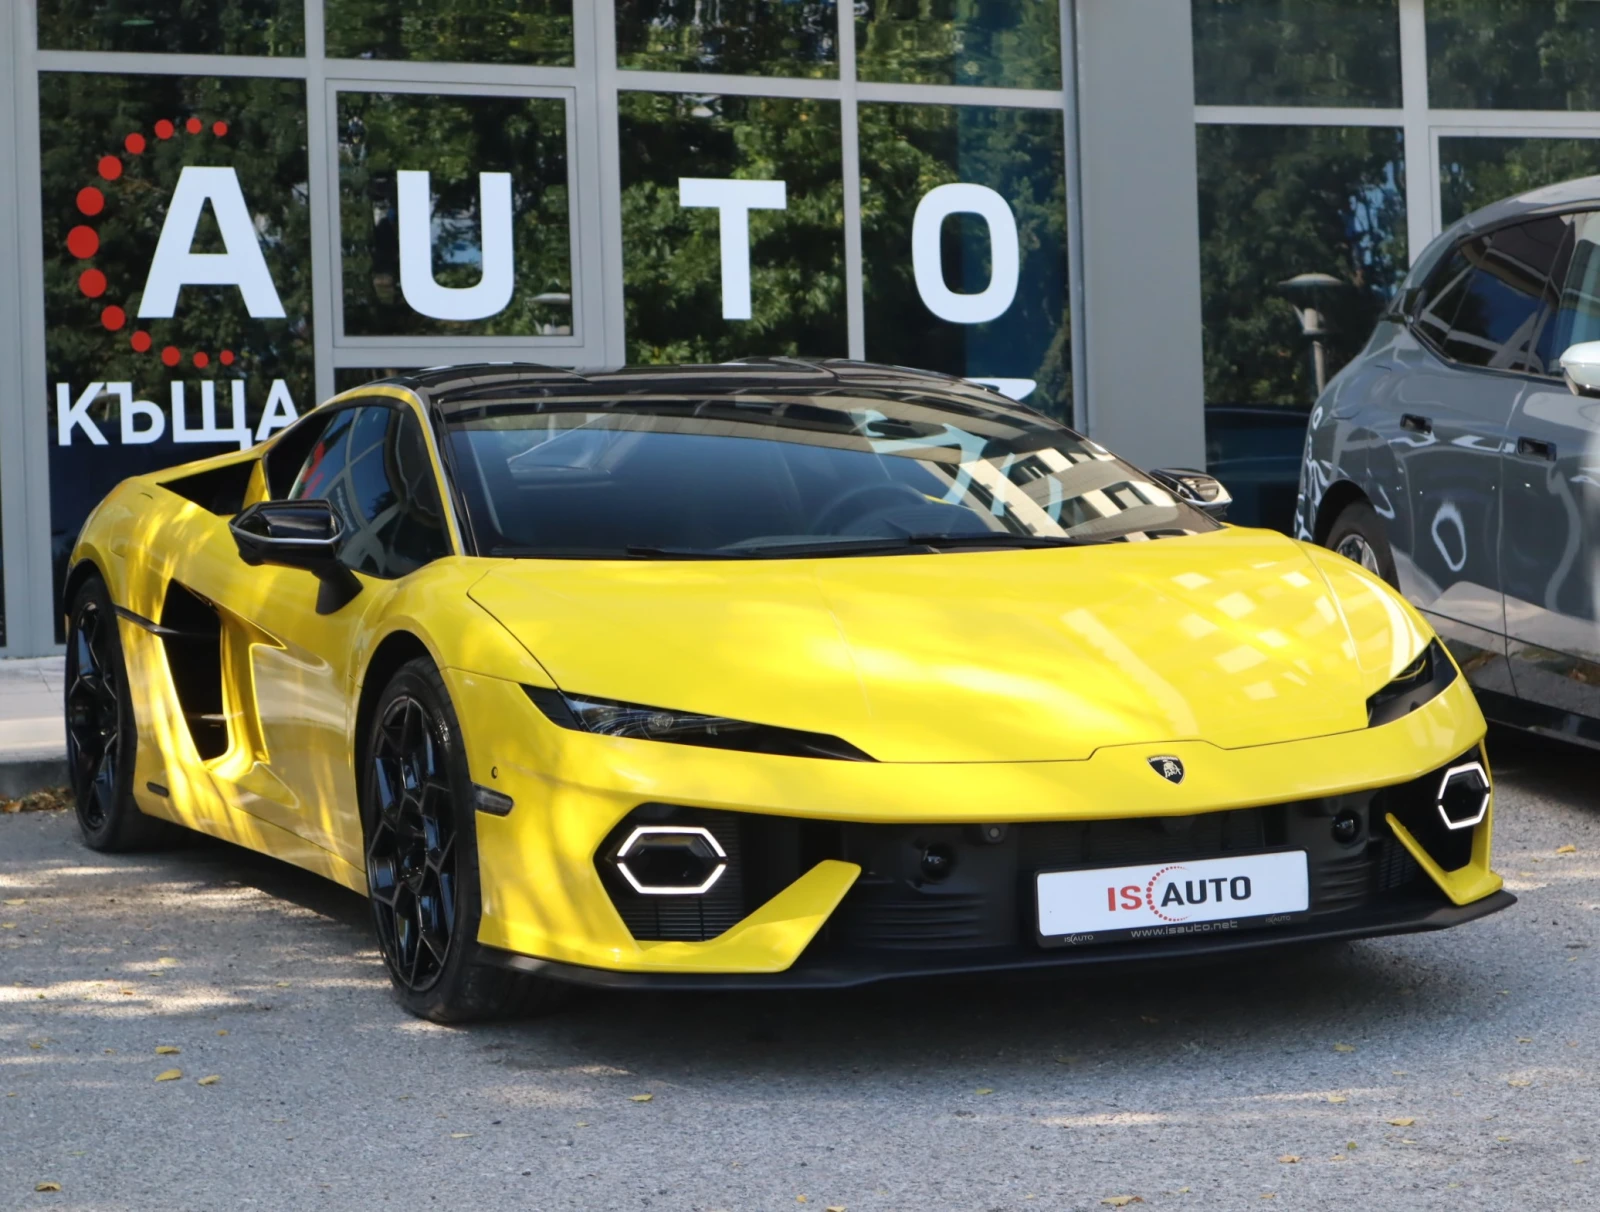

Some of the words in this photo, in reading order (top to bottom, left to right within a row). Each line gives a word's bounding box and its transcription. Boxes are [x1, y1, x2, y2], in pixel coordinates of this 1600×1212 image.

[138, 166, 1019, 323] AUTO
[57, 379, 299, 450] КЪЩА
[1107, 885, 1143, 912] IS
[1161, 876, 1251, 907] AUTO
[1131, 920, 1238, 938] www.isauto.net
